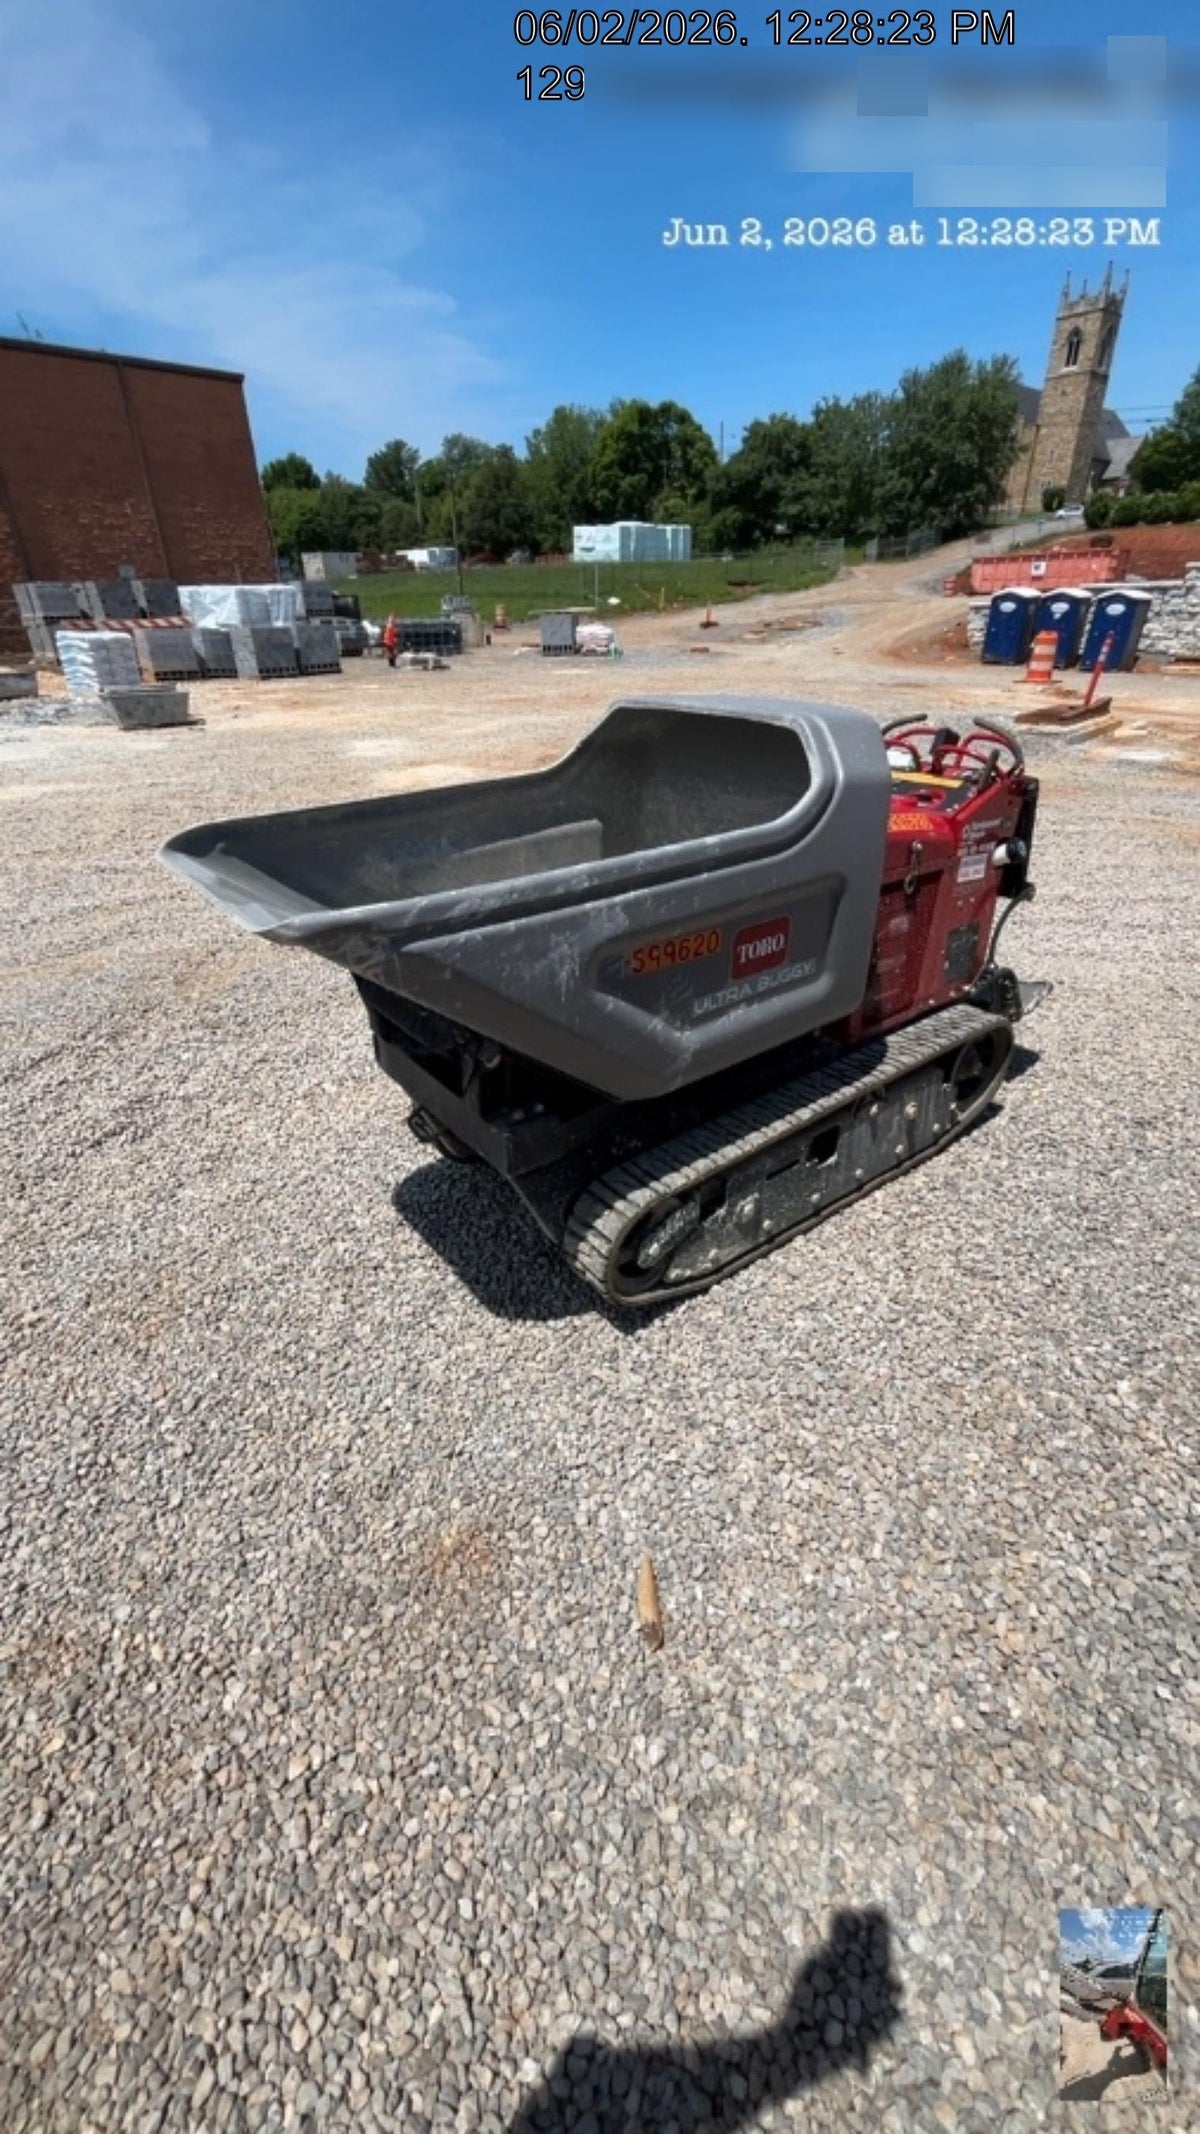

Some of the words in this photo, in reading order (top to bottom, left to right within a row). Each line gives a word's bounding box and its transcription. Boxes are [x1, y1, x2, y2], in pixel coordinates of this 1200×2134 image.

[631, 929, 720, 973] 599620
[738, 933, 785, 964] TORO
[693, 984, 752, 1014] ULTRA
[758, 962, 813, 992] BUGGY
